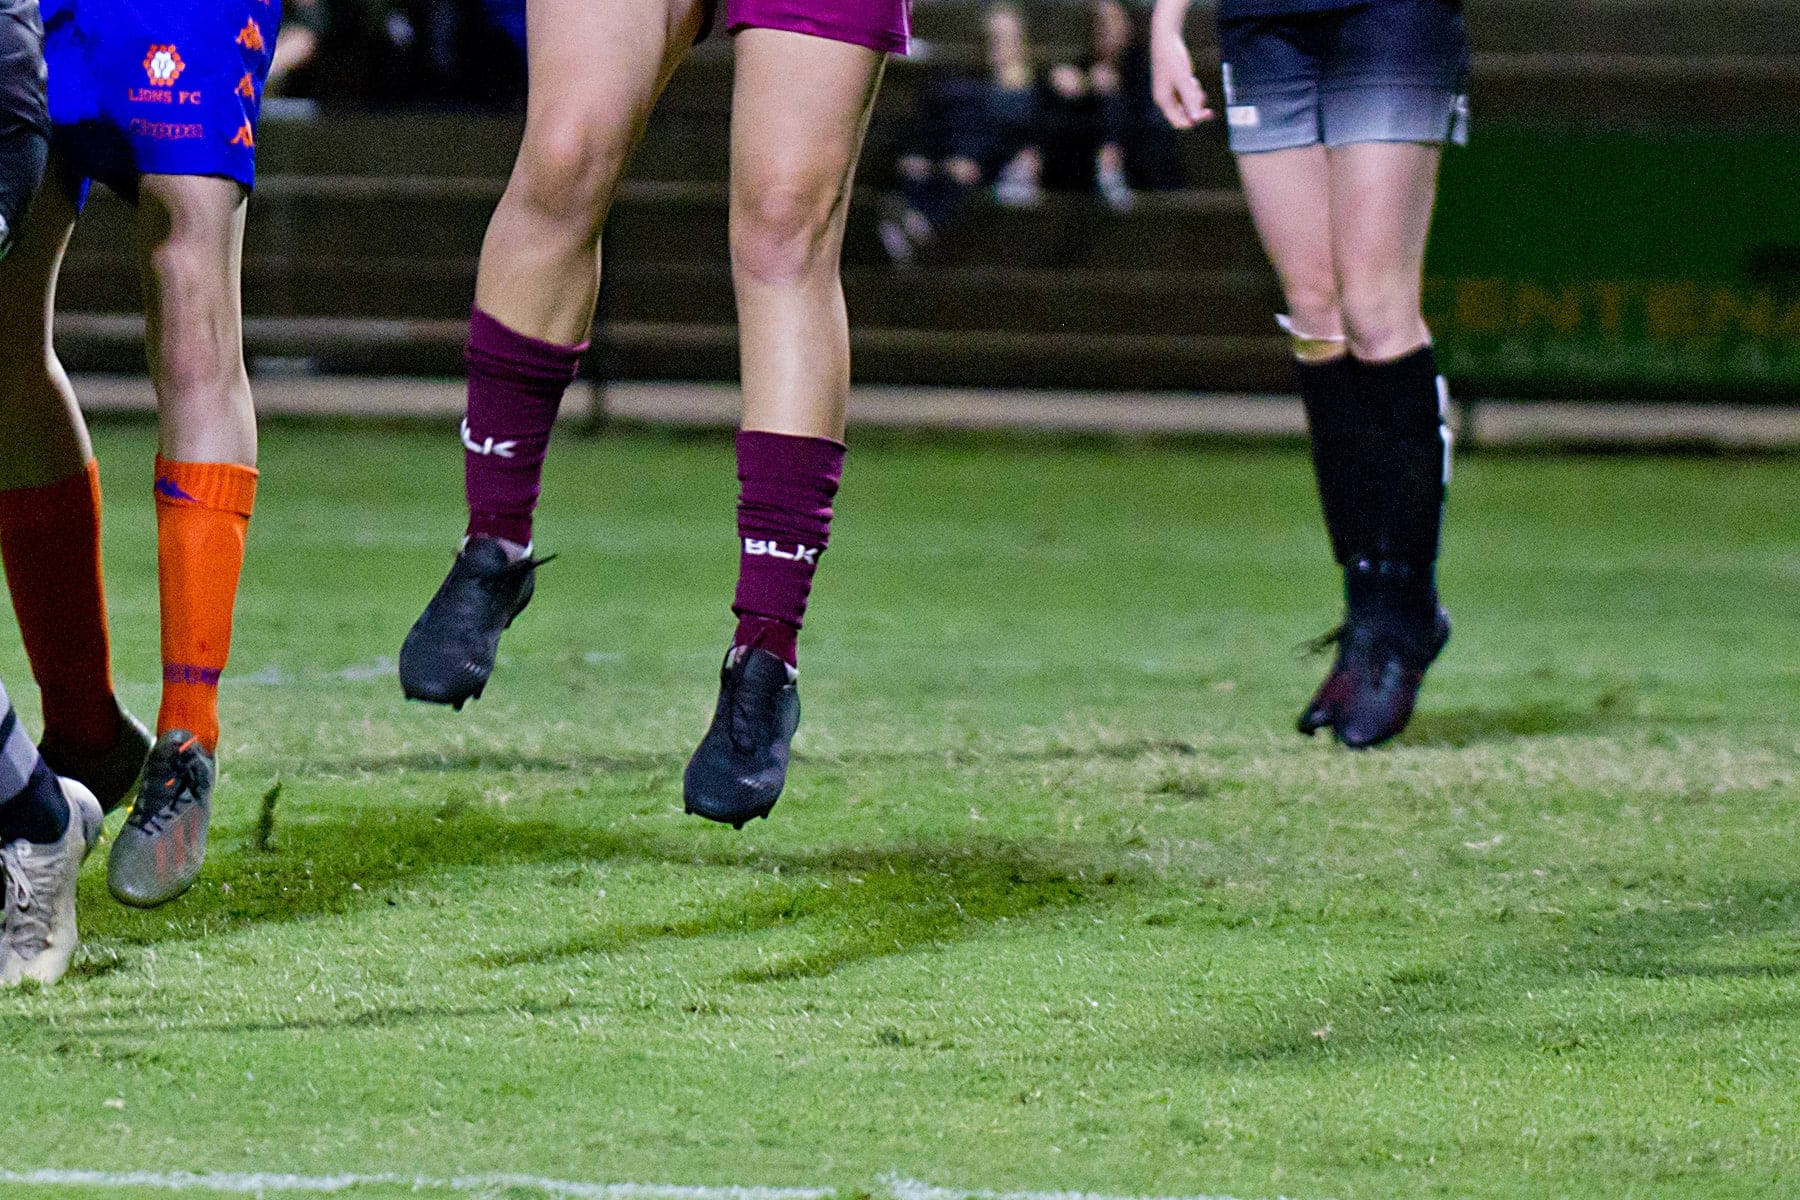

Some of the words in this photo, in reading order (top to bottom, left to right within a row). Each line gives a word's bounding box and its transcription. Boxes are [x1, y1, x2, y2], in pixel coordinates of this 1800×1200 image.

[128, 88, 172, 104] LIONS
[179, 91, 202, 105] FC
[460, 417, 518, 459] LK
[745, 538, 818, 565] BLK
